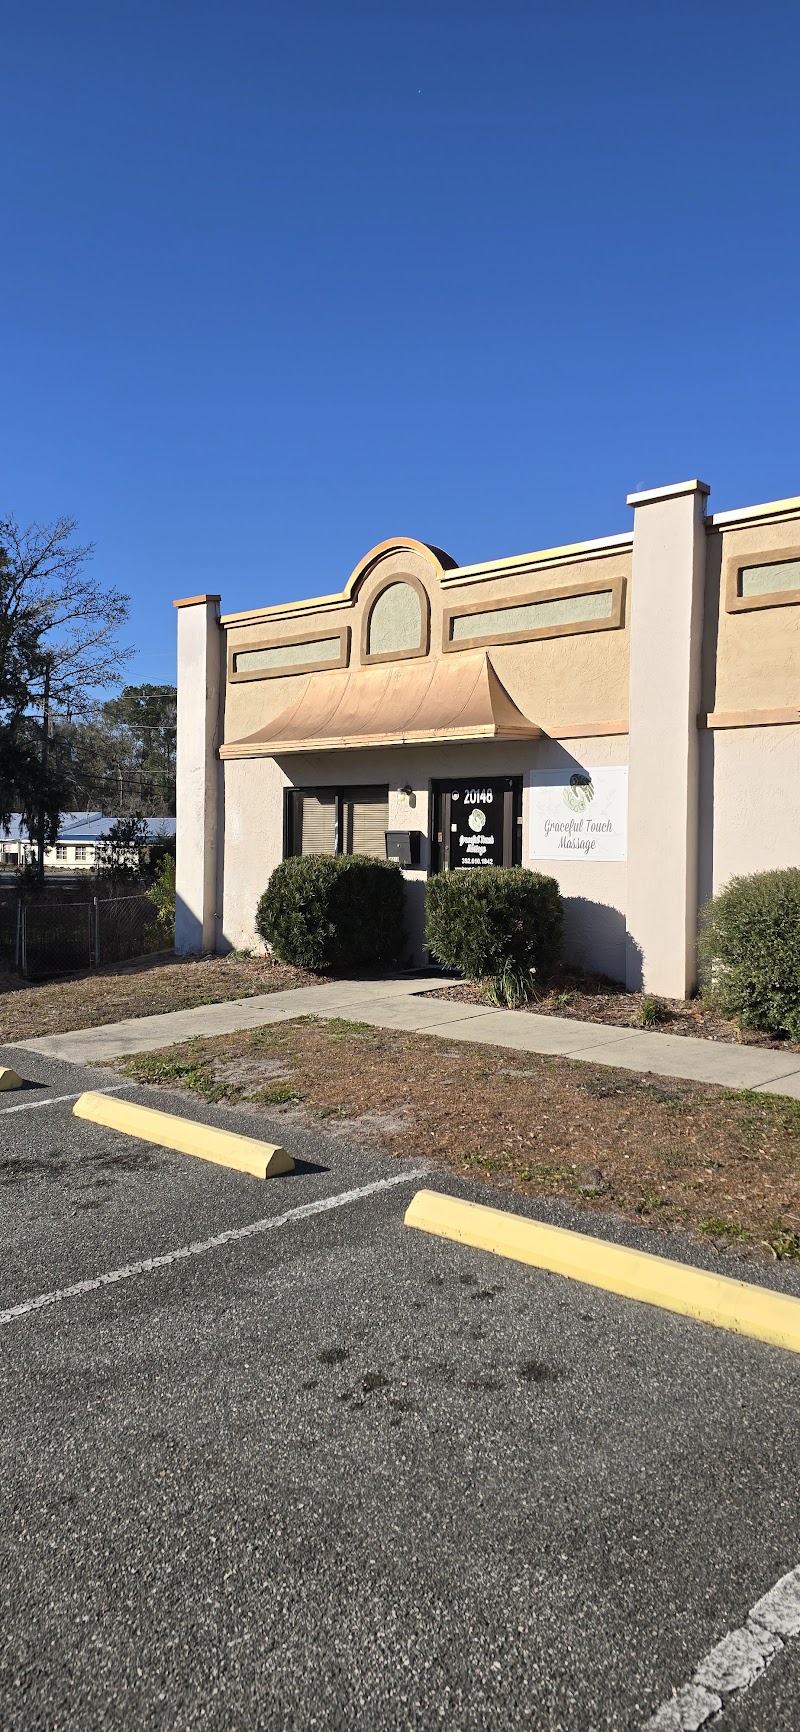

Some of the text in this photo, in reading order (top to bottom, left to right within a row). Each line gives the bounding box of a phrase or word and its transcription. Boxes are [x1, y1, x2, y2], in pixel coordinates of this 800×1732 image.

[464, 788, 493, 804] 20148
[544, 819, 612, 837] Graceful Touch
[558, 836, 596, 855] Massage
